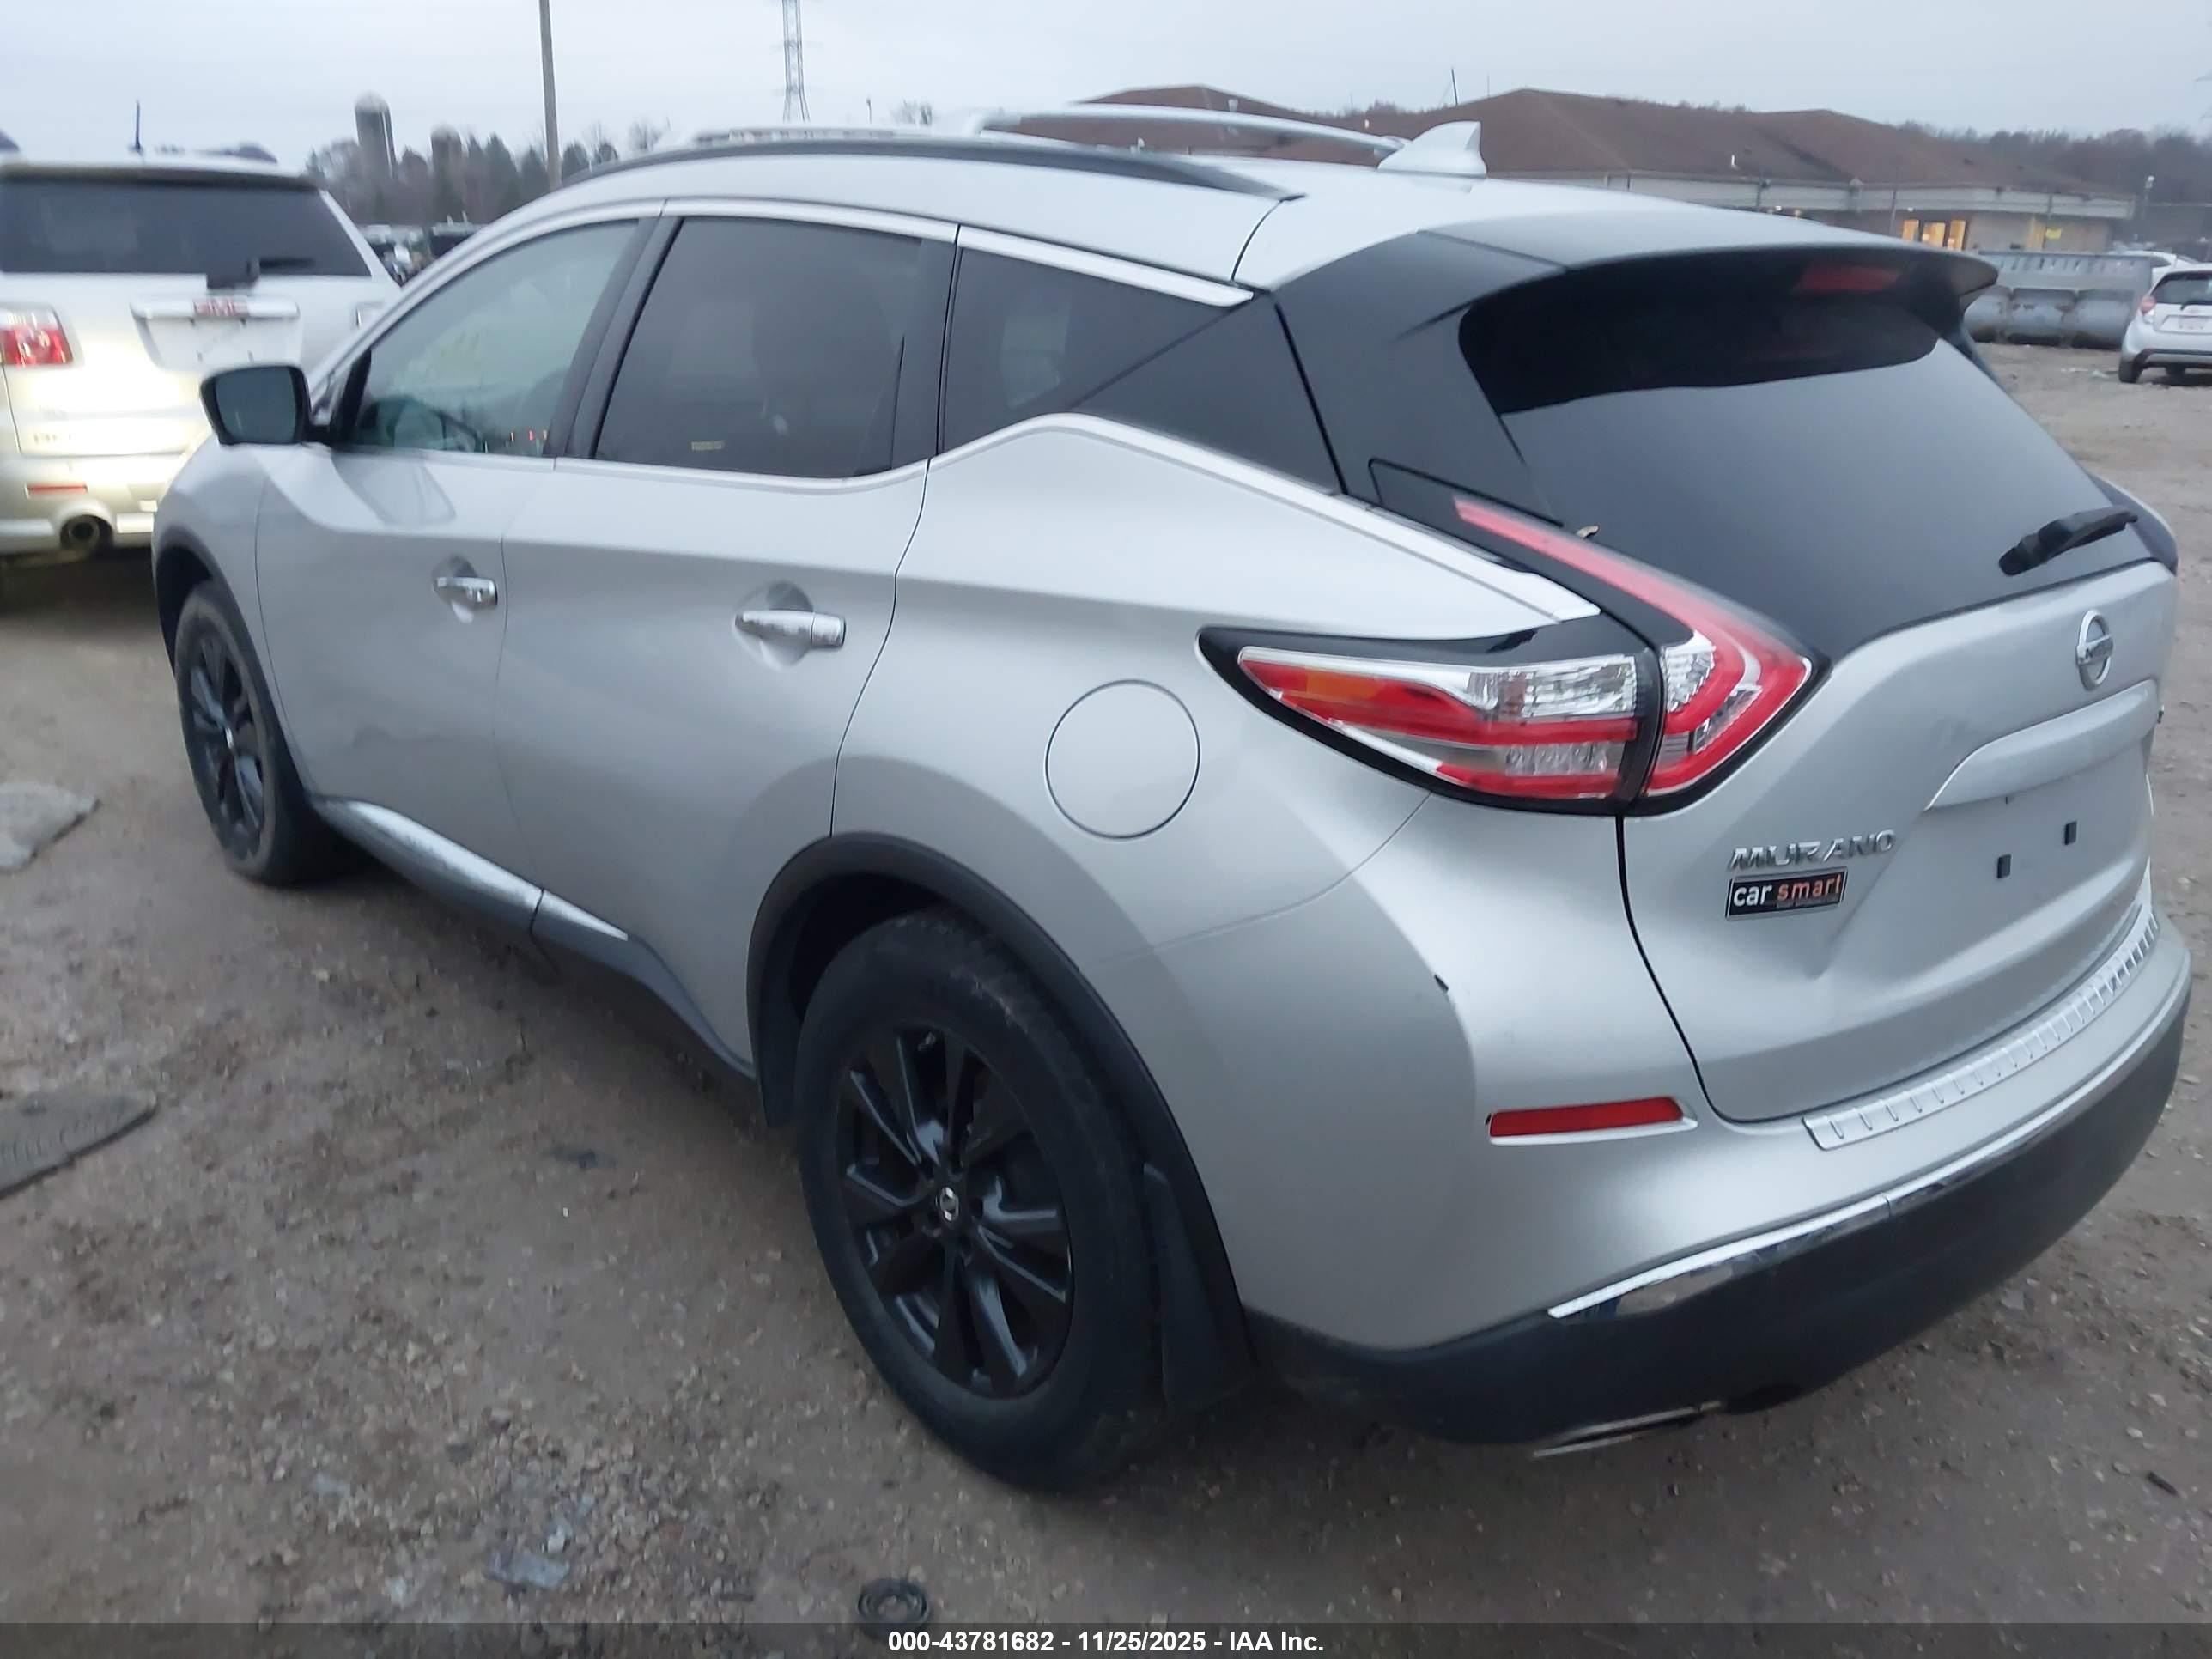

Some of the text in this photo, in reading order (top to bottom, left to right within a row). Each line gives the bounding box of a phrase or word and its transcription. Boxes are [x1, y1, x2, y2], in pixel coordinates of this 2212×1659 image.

[1728, 829, 1896, 870] MURANO
[1733, 884, 1772, 908] car
[1777, 873, 1842, 902] smart
